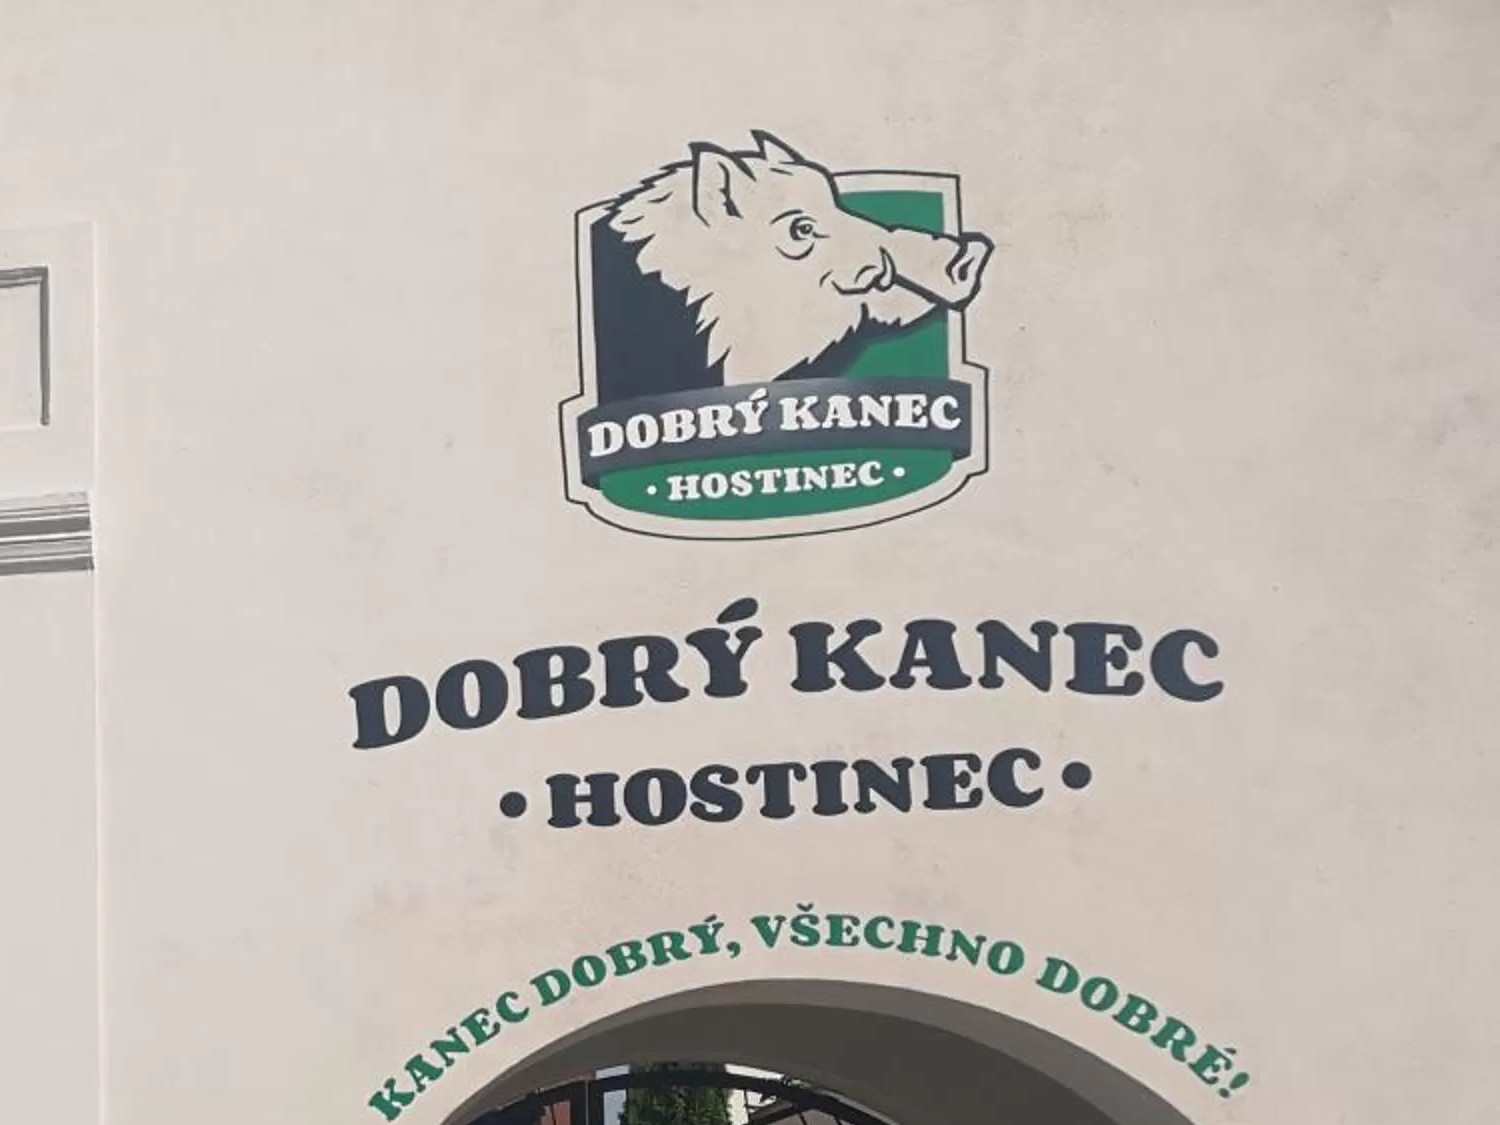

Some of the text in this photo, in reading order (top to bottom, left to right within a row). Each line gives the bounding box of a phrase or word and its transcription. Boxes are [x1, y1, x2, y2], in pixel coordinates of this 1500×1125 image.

[588, 387, 962, 457] DOBRÝ KANEC
[668, 460, 886, 501] HOSTINEC
[348, 597, 1224, 750] DOBRÝ KANEC
[545, 747, 1045, 829] HOSTINEC
[367, 902, 1253, 1122] KANEC DOBRÝ, VŠECHNO DOBRÉ!
